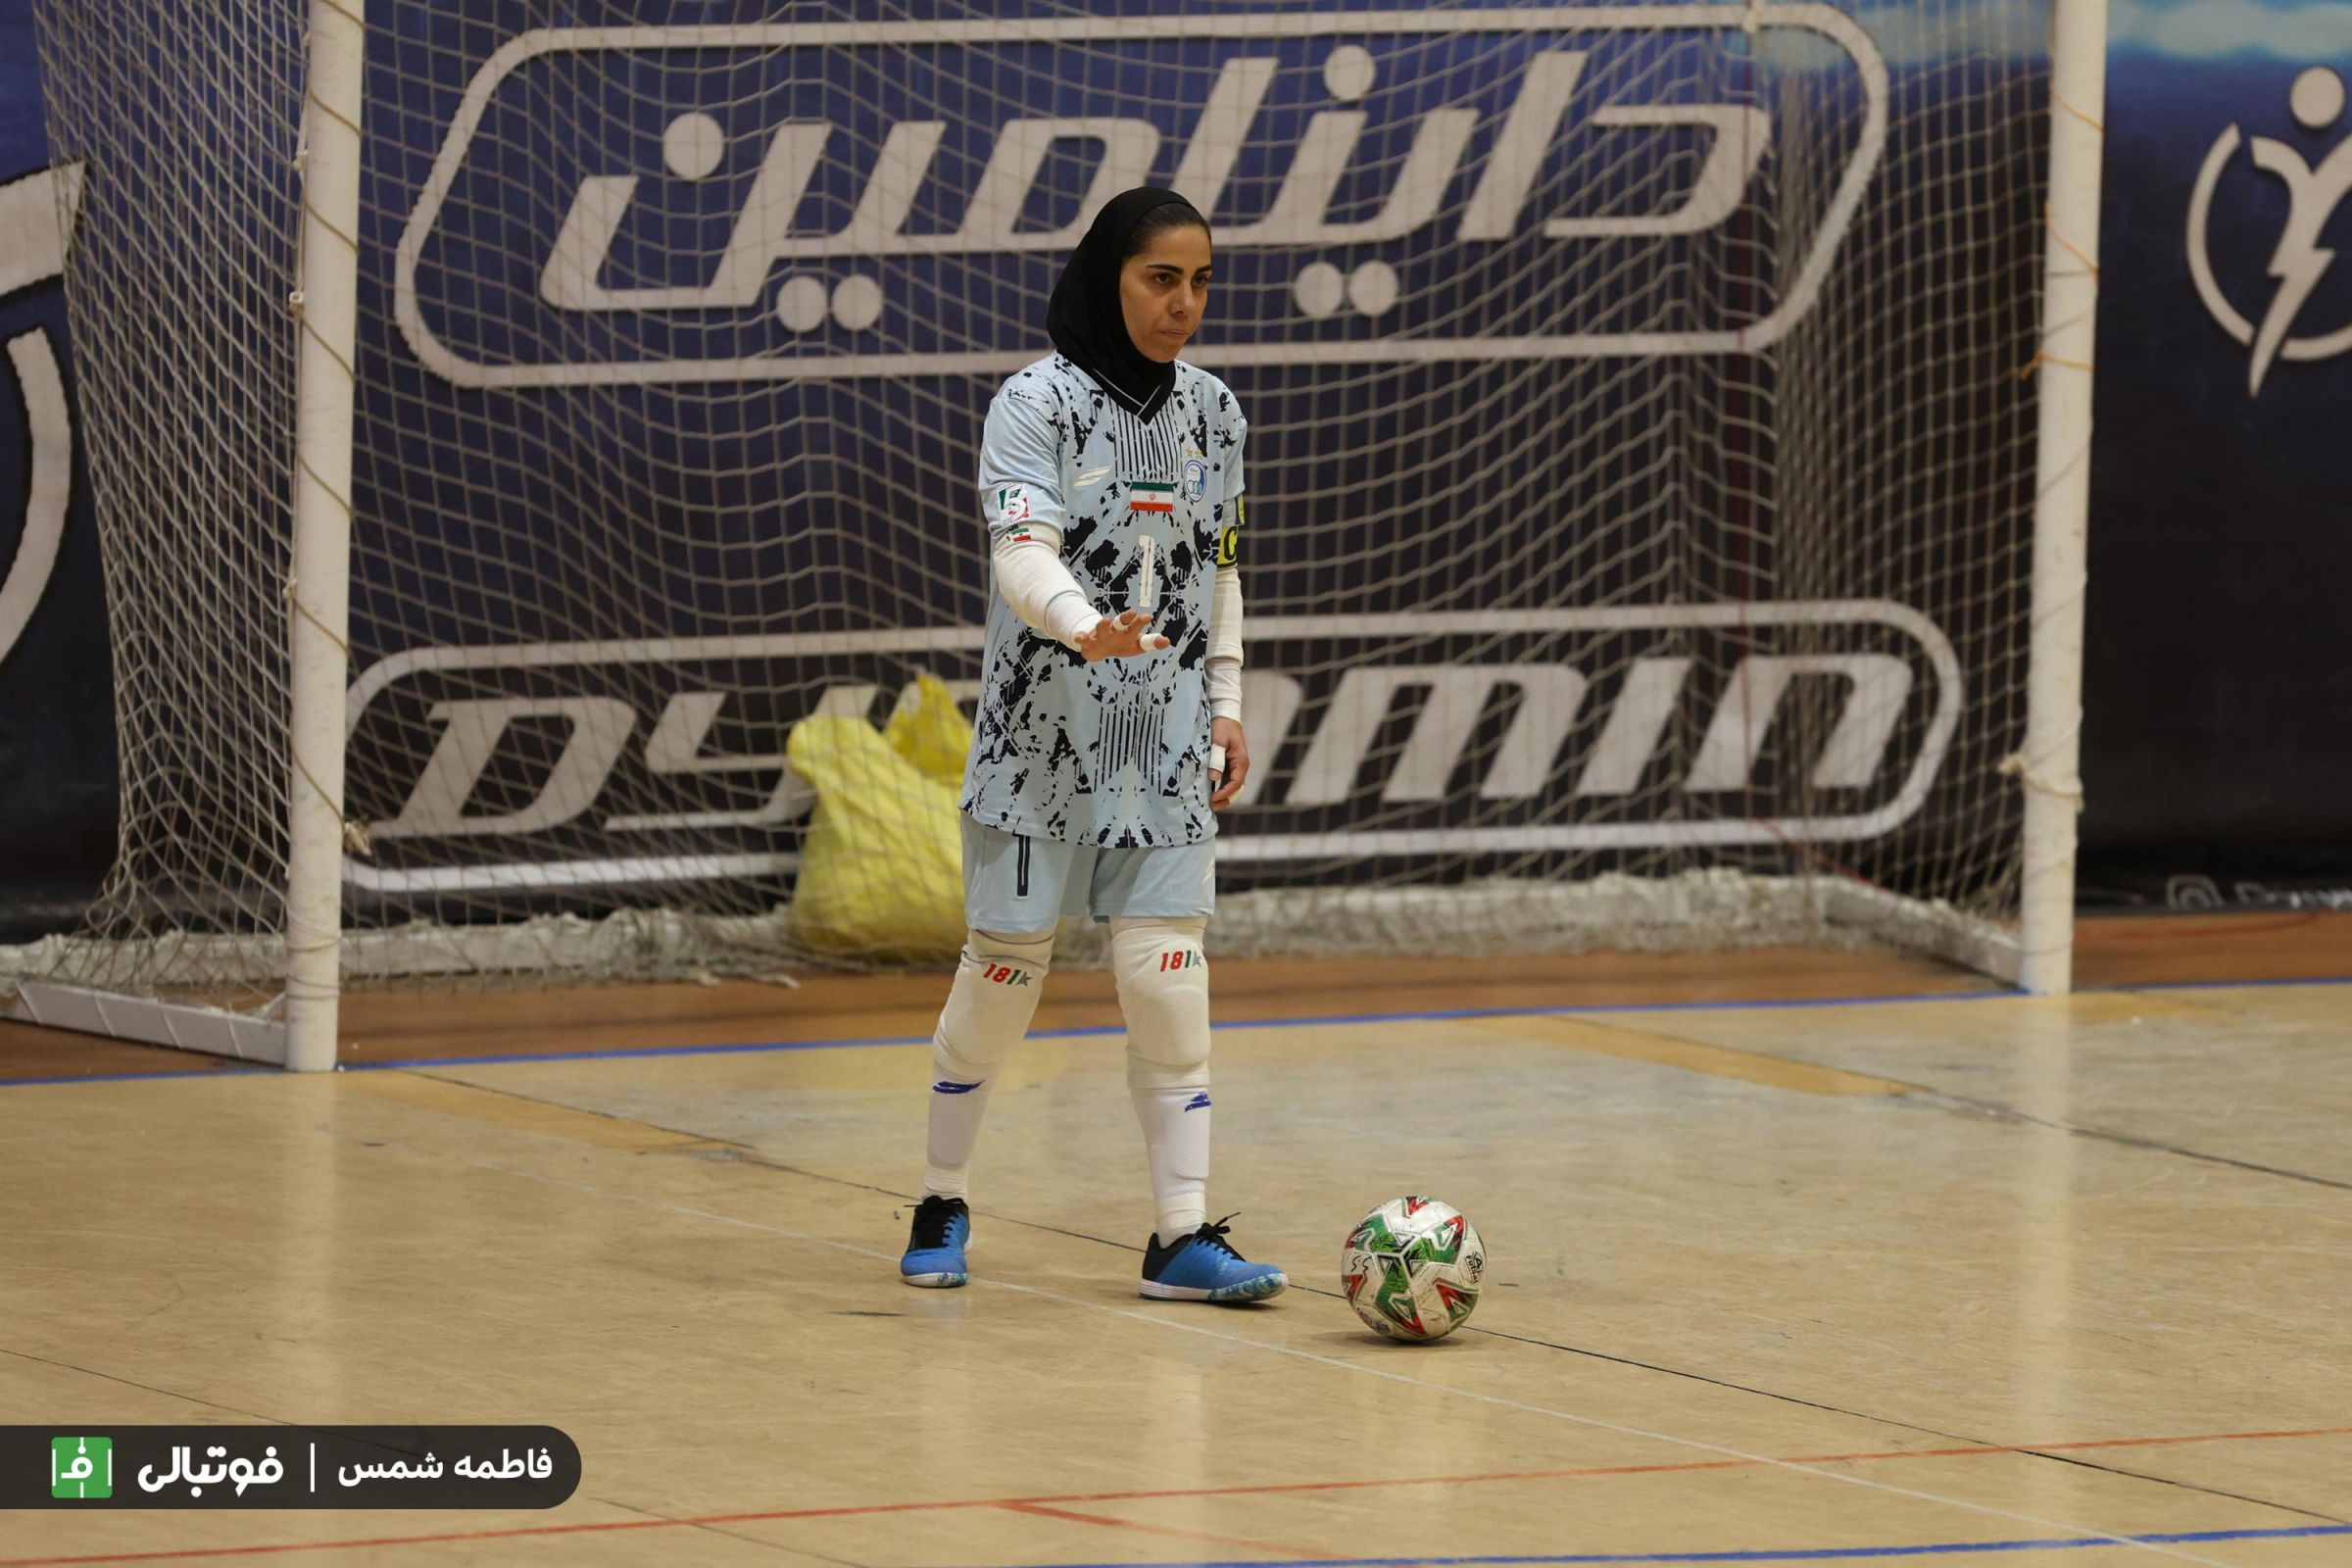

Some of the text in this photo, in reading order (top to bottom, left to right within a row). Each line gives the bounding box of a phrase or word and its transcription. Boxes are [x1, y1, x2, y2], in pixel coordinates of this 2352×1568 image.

[1139, 535, 1154, 608] 1
[1160, 950, 1193, 972] 181
[983, 962, 1021, 986] 181
